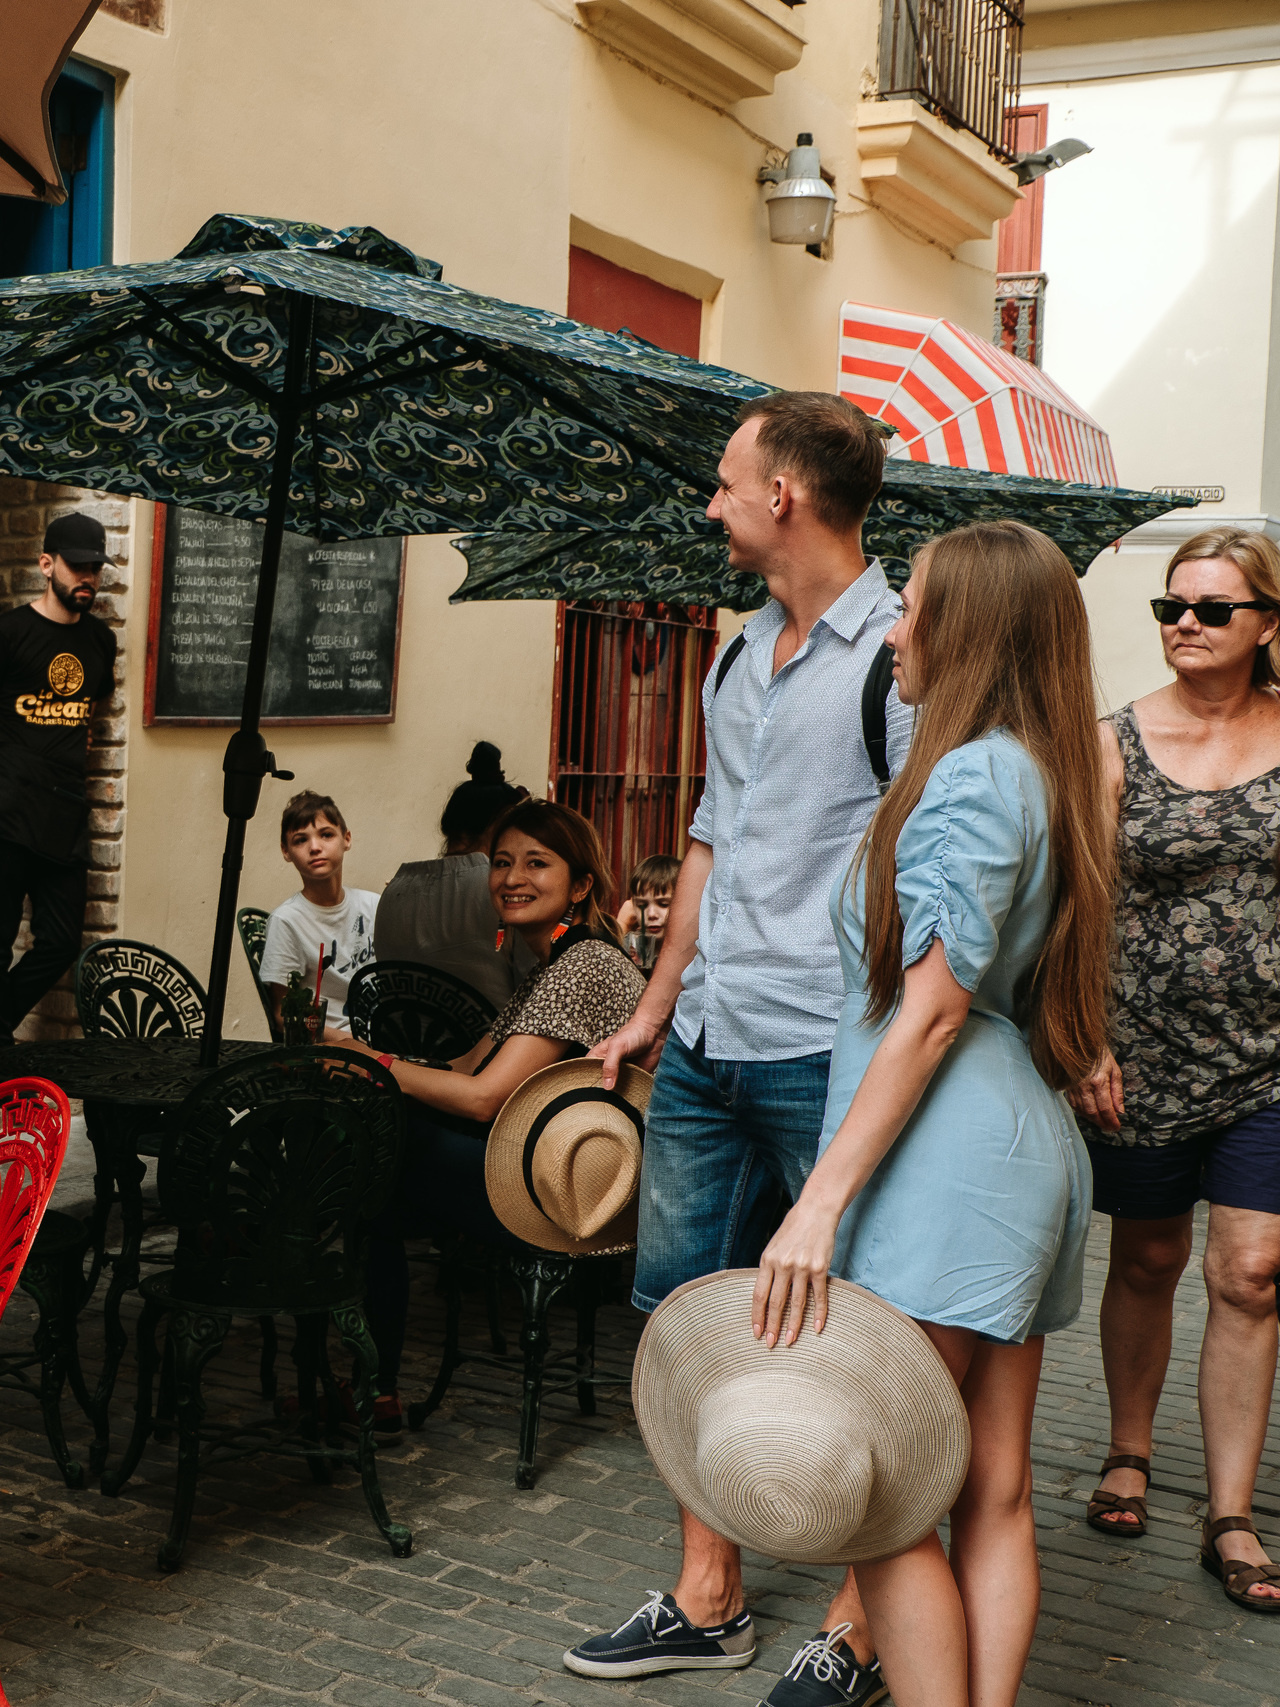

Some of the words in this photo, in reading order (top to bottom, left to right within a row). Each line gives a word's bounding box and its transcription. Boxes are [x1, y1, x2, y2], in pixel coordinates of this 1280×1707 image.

[1180, 489, 1220, 498] IGNACIO
[39, 689, 53, 699] La
[16, 694, 90, 719] Cucañ
